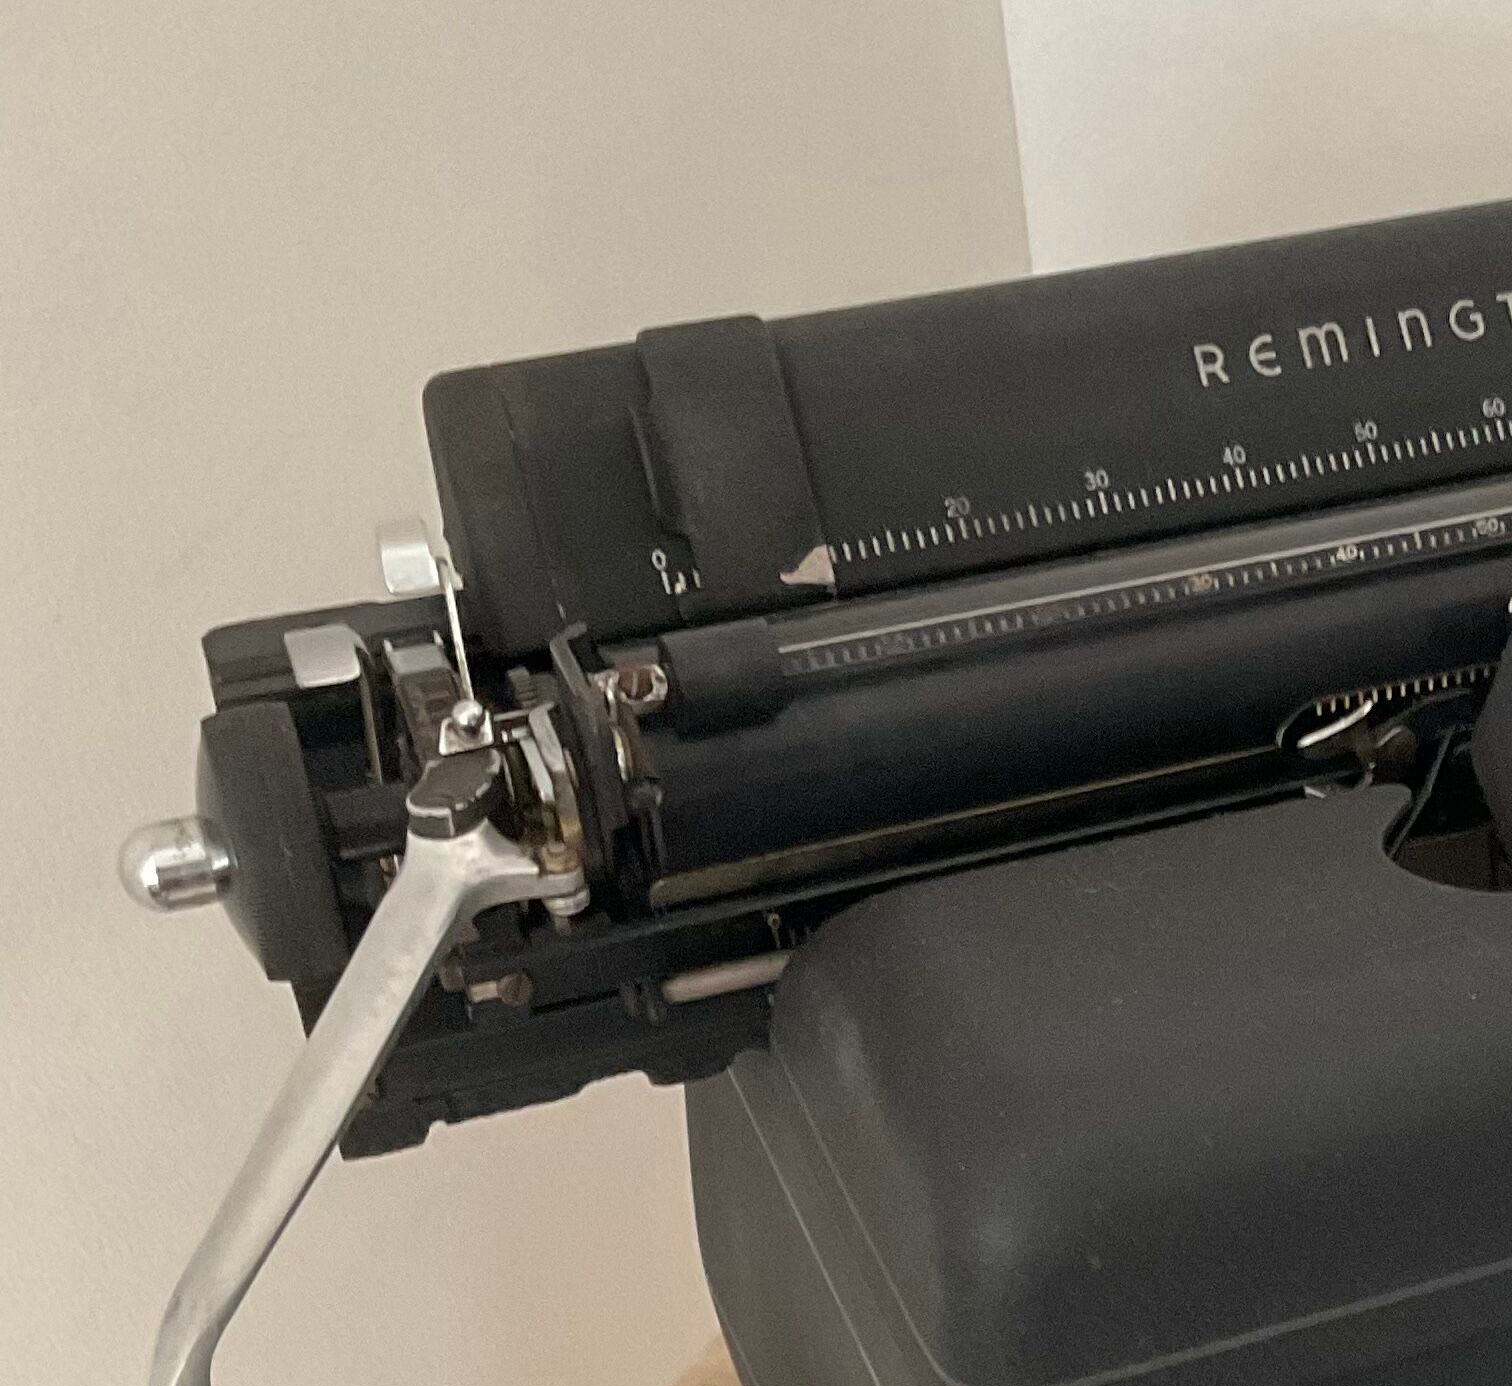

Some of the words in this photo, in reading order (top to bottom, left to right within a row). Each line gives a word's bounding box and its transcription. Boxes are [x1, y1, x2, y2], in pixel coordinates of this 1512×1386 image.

[1083, 469, 1106, 491] 30
[1224, 445, 1246, 465] 40
[1354, 420, 1377, 442] 50
[1483, 397, 1504, 418] 60
[1336, 545, 1357, 561] 40
